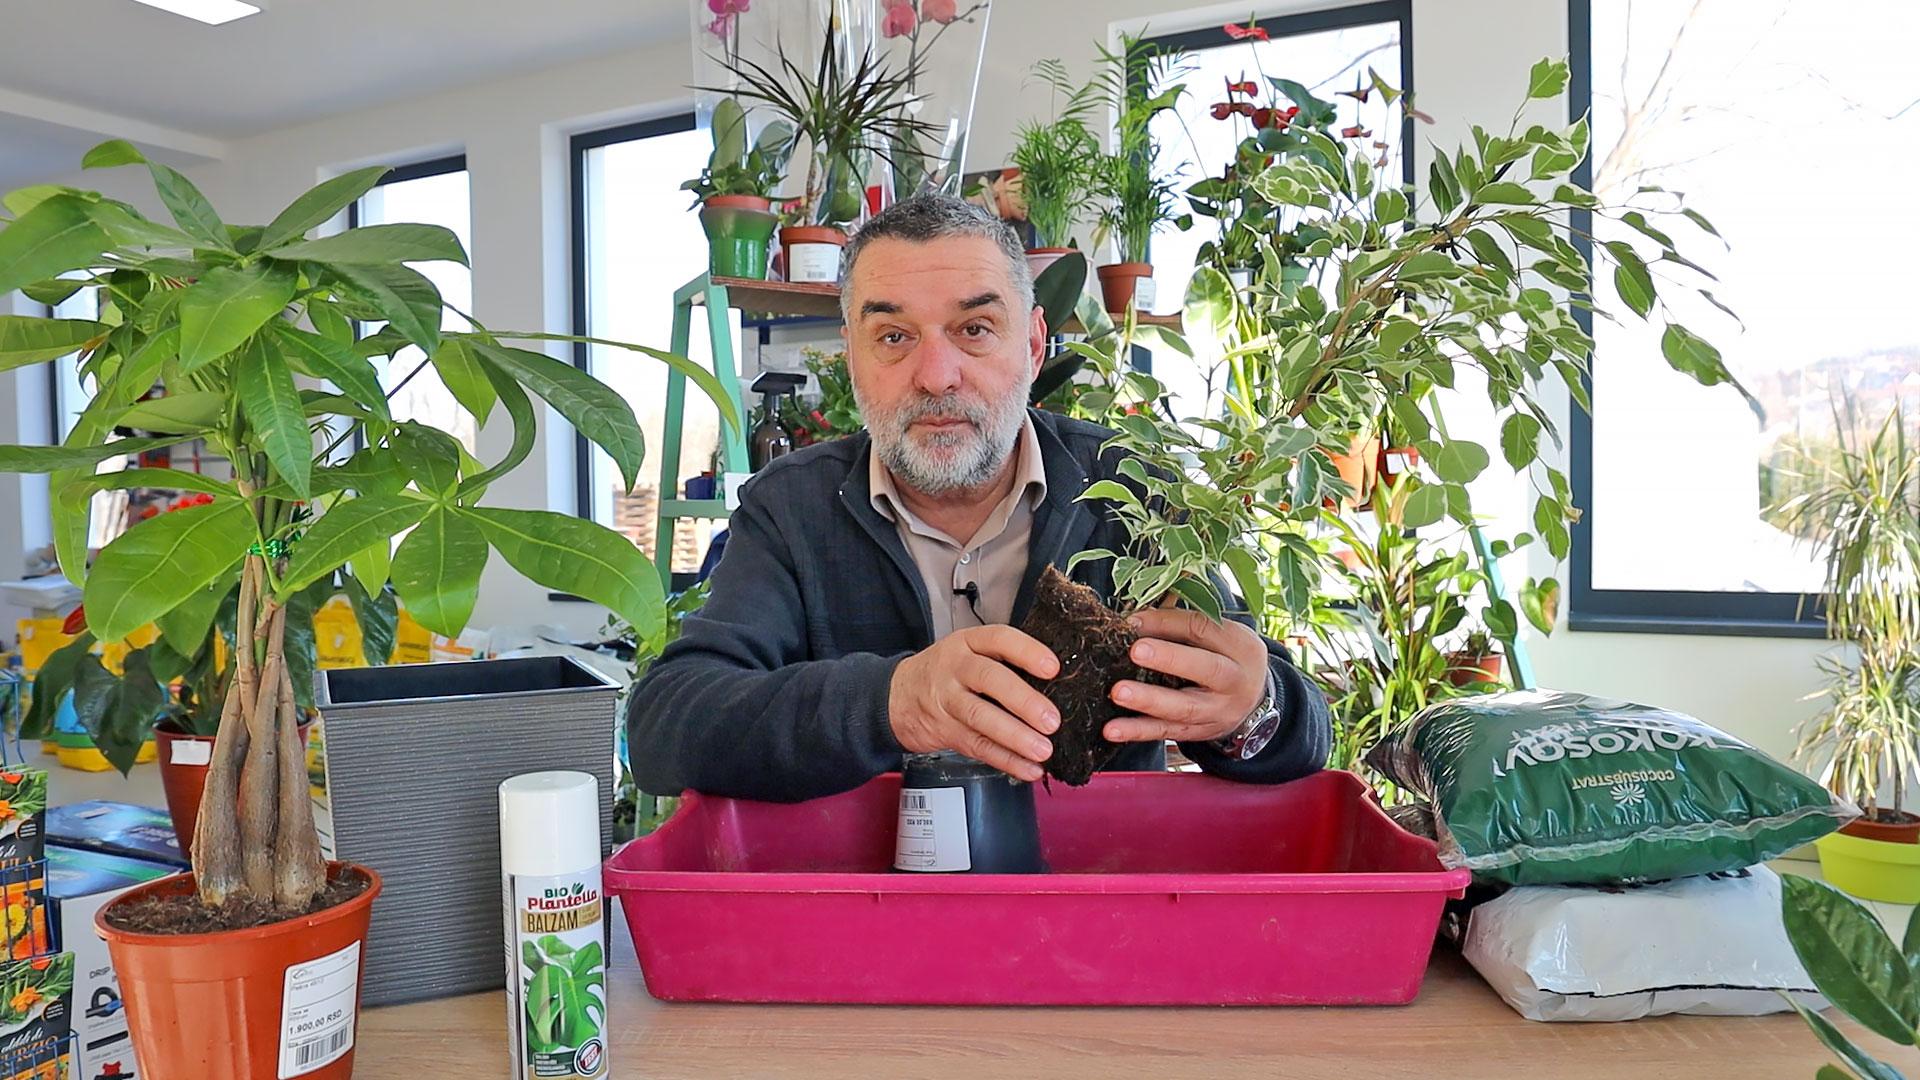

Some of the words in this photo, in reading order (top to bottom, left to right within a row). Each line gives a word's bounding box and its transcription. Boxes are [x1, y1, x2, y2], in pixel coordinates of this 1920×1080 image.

[1571, 769, 1675, 790] COCOSUBSTRAT
[527, 890, 597, 910] Plantella
[544, 887, 568, 898] BIO
[527, 910, 578, 933] BALZAM
[289, 1017, 325, 1035] 1.900,00
[327, 1009, 342, 1023] RSD
